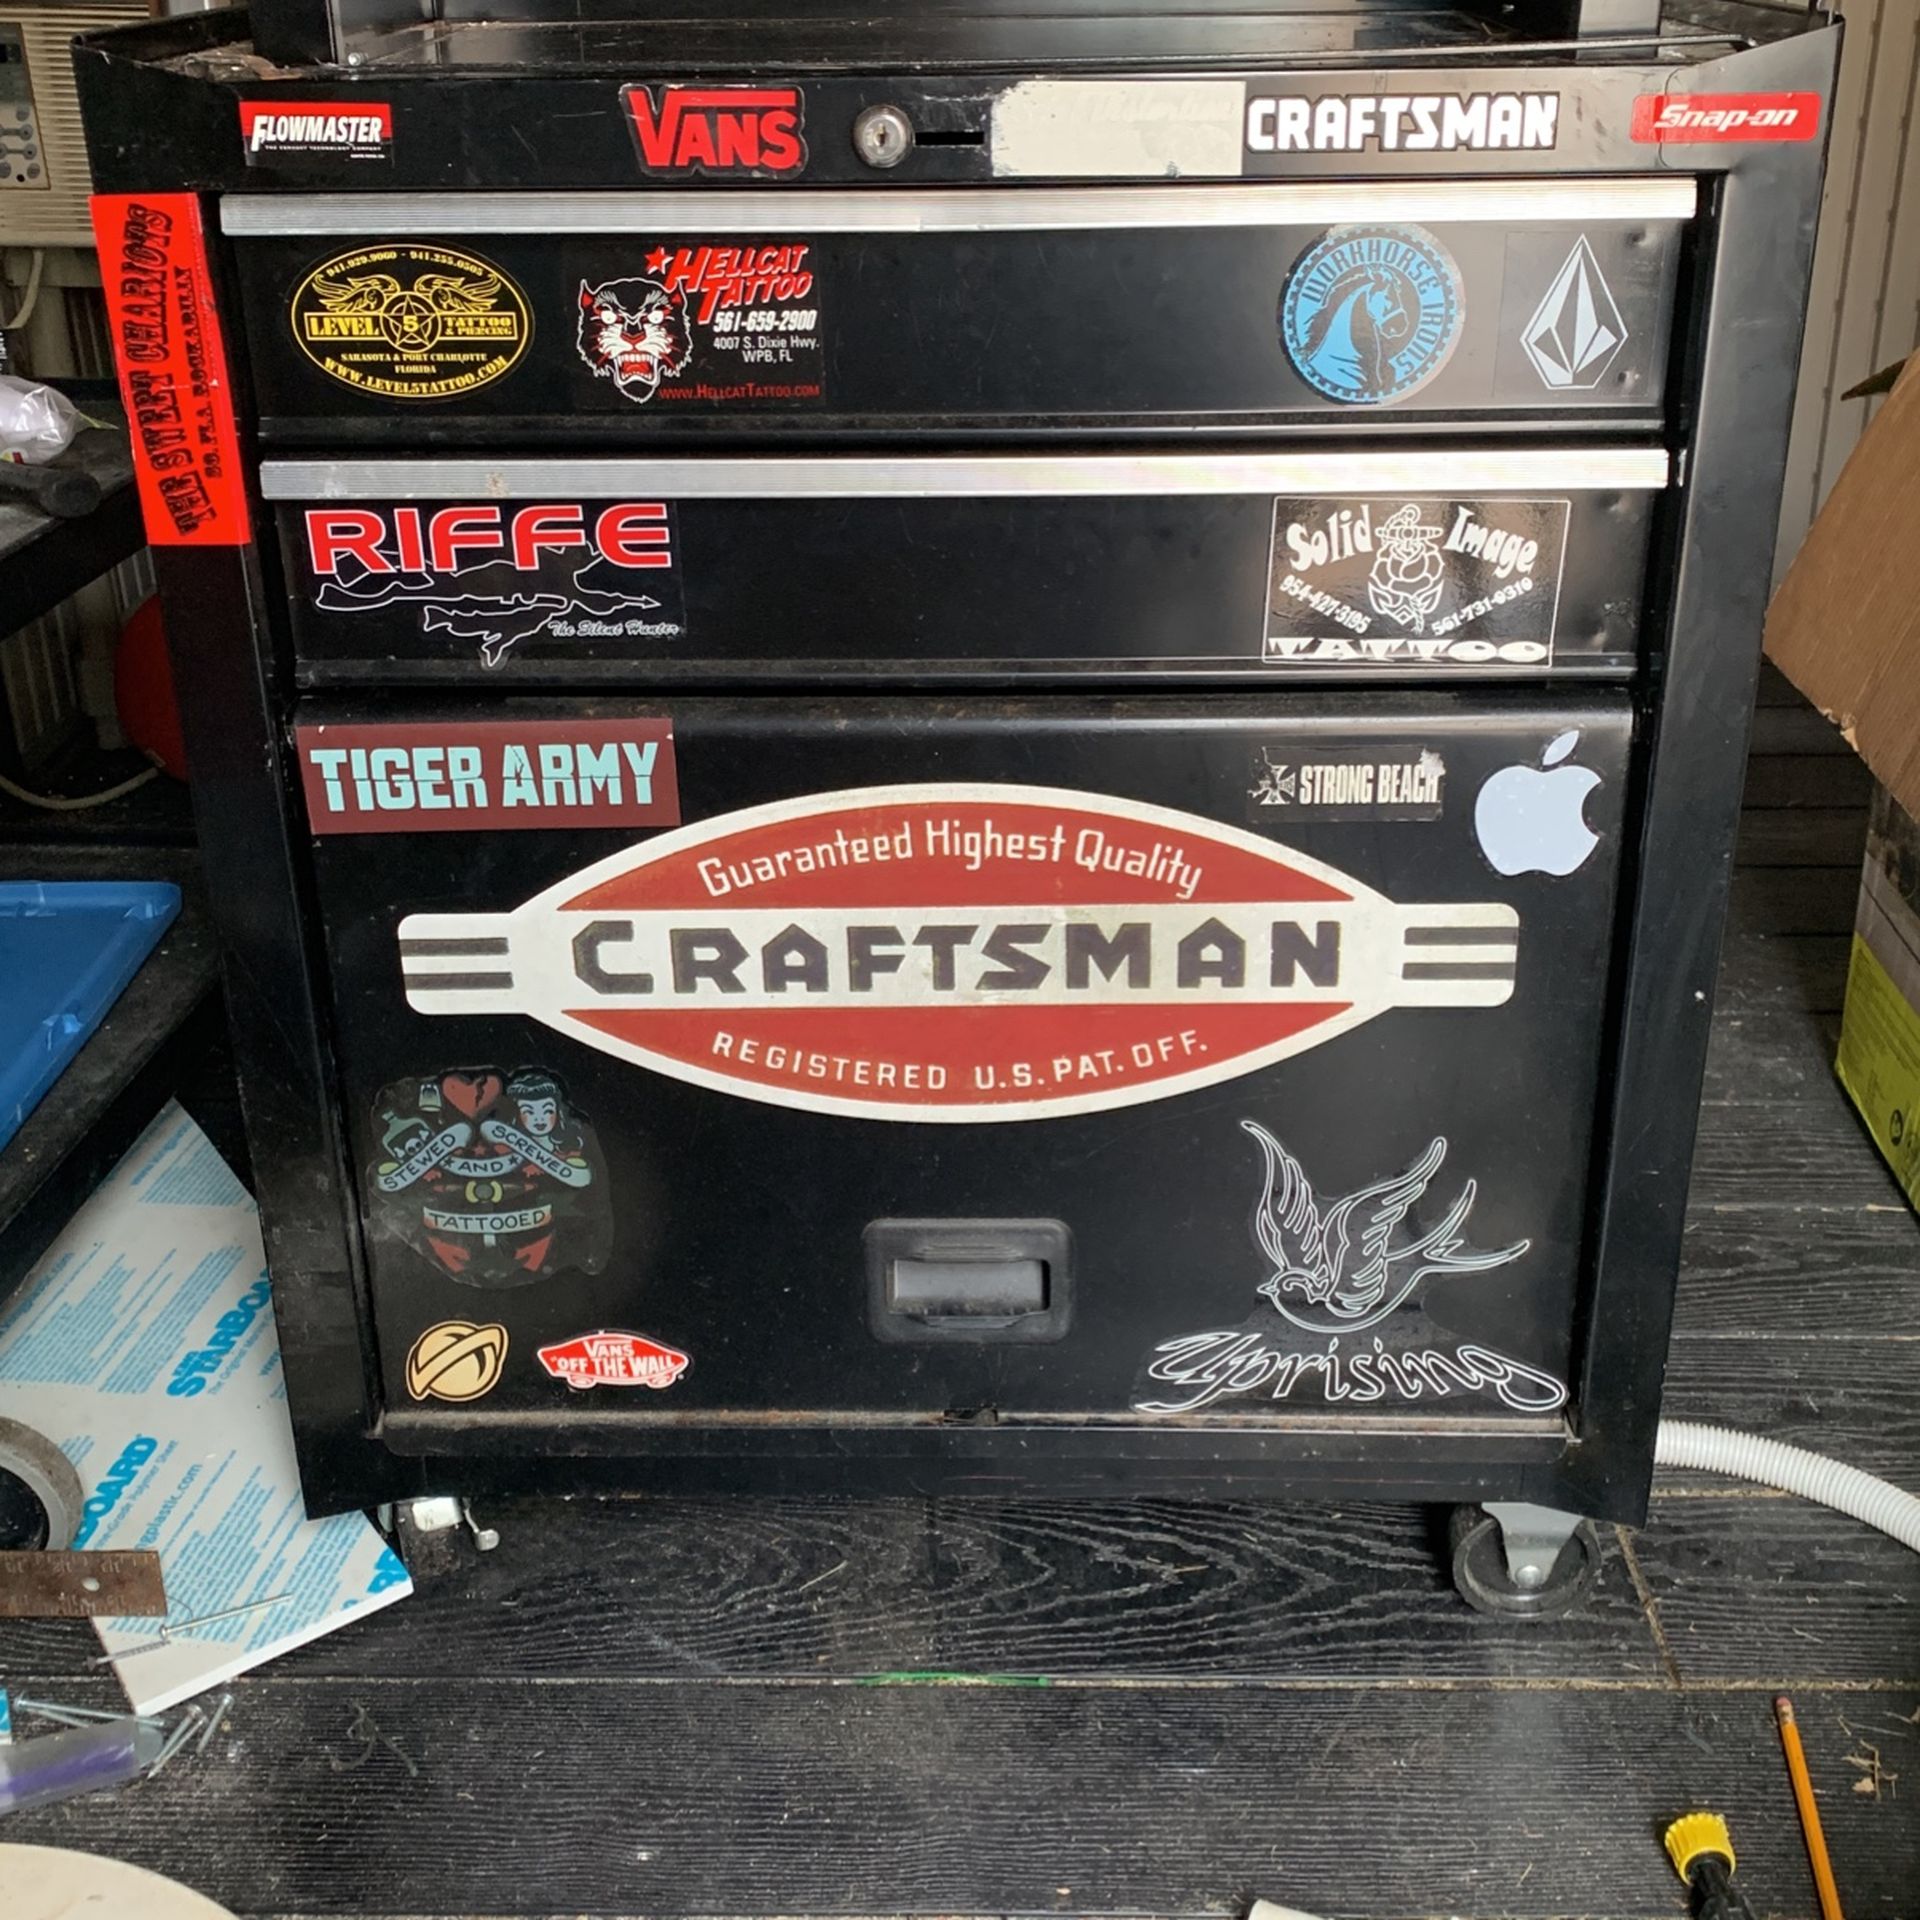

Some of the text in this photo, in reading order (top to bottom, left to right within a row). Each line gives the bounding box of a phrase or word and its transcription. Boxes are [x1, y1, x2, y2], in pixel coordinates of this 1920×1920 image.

[251, 115, 382, 152] FLOWMASTER
[628, 90, 801, 170] VANS
[1247, 95, 1559, 150] CRAFTSMAN
[1653, 104, 1799, 132] Snap-on
[664, 246, 809, 293] HELLCAT
[697, 272, 813, 325] TATTOO
[1301, 239, 1444, 375] WORKHORSE IRONS
[174, 266, 211, 398] ROCKABILLY
[309, 315, 512, 336] LEVEL 5 TATTOO
[457, 327, 512, 335] PIERCING
[713, 310, 818, 332] 561-659-2900
[341, 353, 391, 362] SARASOTA
[403, 353, 428, 362] PORT
[430, 353, 487, 363] CHARLOTTE
[713, 335, 820, 351] 4007 S. Dixie Hwy.
[742, 351, 793, 364] WPB, FL
[121, 203, 217, 536] THE SWEET CHARIOTS
[323, 355, 508, 395] WWW.LEVEL5TATTOO.COM
[395, 365, 436, 374] FLORIDA
[305, 503, 672, 575] RIFFE
[1286, 504, 1538, 579] Solid Image
[547, 619, 680, 637] The Silent Hunter
[1268, 637, 1547, 663] TATTOO
[310, 741, 658, 812] TIGER ARMY
[1299, 764, 1374, 804] STRONG
[697, 820, 1202, 900] Guaranteed Highest Quality
[571, 916, 1340, 995] CRAFTSMAN
[711, 1030, 1208, 1090] REGISTERED U.S. PAT. OFF.
[384, 1133, 456, 1189] STEWED
[459, 1159, 505, 1174] AND
[491, 1125, 572, 1179] SCREWED
[429, 1210, 546, 1231] TATTOOED
[582, 1340, 635, 1358] VANS
[591, 1358, 629, 1377] THE
[1135, 1332, 1568, 1413] Uprising
